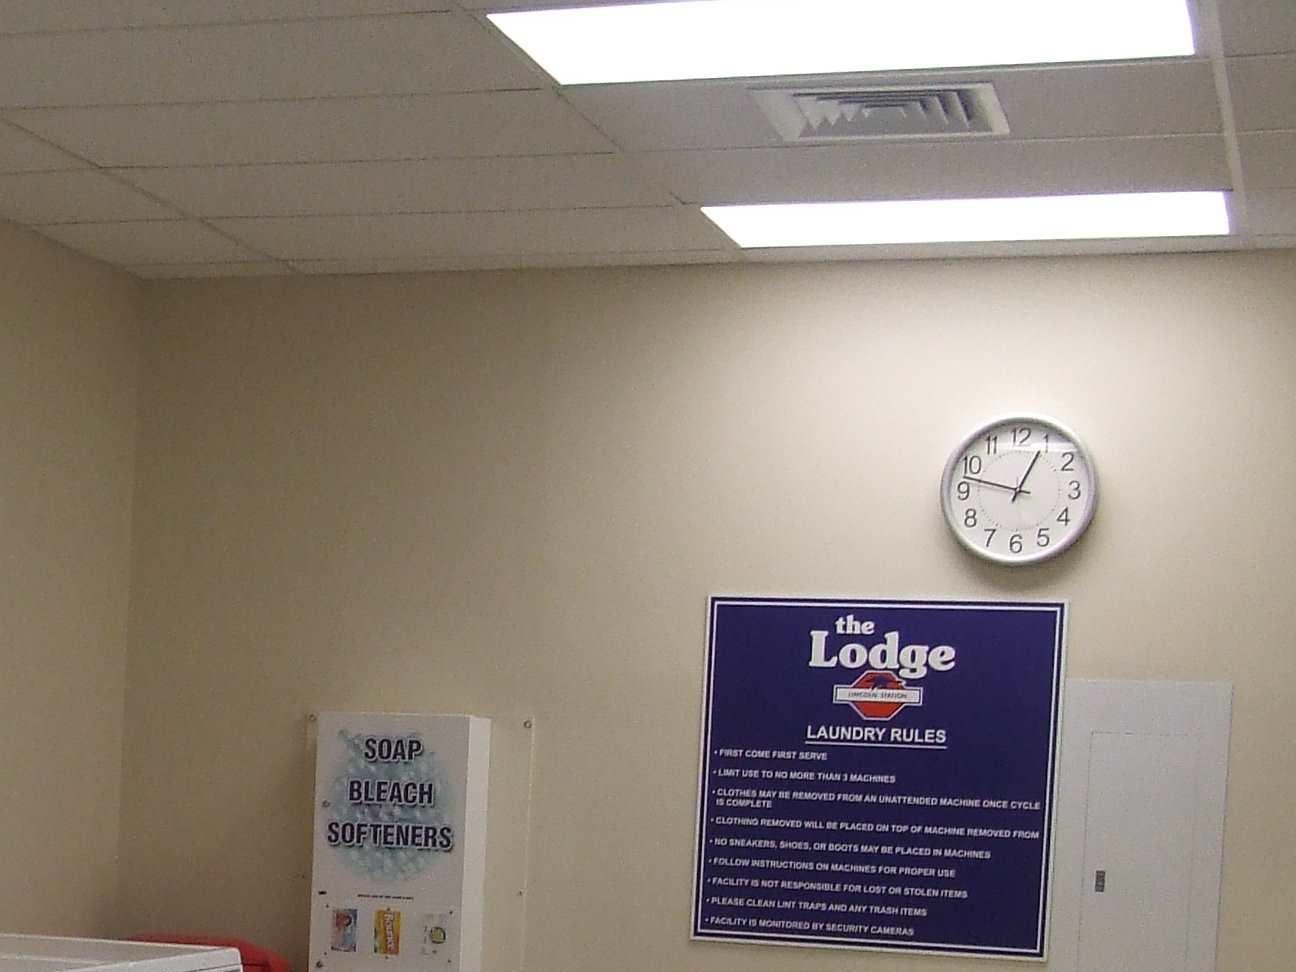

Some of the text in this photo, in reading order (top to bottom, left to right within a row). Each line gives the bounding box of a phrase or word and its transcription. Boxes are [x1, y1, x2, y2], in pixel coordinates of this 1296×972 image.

[986, 435, 997, 455] 11
[1011, 427, 1031, 444] 12
[1043, 434, 1048, 453] 1
[963, 456, 982, 474] 10
[1061, 452, 1074, 471] 2
[957, 481, 970, 501] 9
[1068, 480, 1081, 499] 3
[964, 508, 977, 527] 8
[1056, 508, 1070, 526] 4
[984, 529, 996, 547] 7
[1009, 535, 1022, 553] 6
[1037, 528, 1049, 547] 5
[835, 614, 875, 634] the
[809, 630, 955, 678] Lodge
[807, 726, 946, 743] LAUNDRY RULES
[364, 738, 422, 761] SOAP
[775, 771, 788, 779] NO
[790, 772, 815, 780] MORE
[849, 774, 895, 783] MACHINES
[349, 780, 433, 804] BLEACH
[793, 792, 835, 800] REMOVED
[879, 796, 938, 805] UNATTENDED
[940, 798, 980, 807] MACHINE
[983, 800, 1008, 808] ONCE
[1011, 801, 1040, 809] CYCLE
[726, 799, 772, 808] COMPLETE
[328, 822, 452, 848] SOFTENERS
[716, 817, 758, 825] CLOTHING
[761, 819, 801, 827] REMOVED
[804, 820, 824, 828] WILL
[840, 822, 873, 831] PLACED
[924, 826, 965, 835] MACHINE
[967, 828, 1010, 837] REMOVED
[1013, 831, 1039, 839] FROM
[828, 843, 858, 851] BOOTS
[861, 844, 880, 854] MAY
[895, 847, 931, 855] PLACED
[944, 849, 990, 859] MACHINES
[713, 858, 749, 866] FOLLOW
[751, 859, 814, 870] INSTRUCTIONS
[831, 864, 876, 873] MACHINES
[899, 867, 935, 876] PROPER
[937, 869, 955, 877] USE
[712, 878, 749, 886] FACILITY
[751, 879, 759, 887] IS
[761, 880, 779, 888] NOT
[781, 881, 840, 891] RESPONSIBLE
[843, 884, 861, 892] FOR
[864, 886, 886, 894] LOST
[904, 888, 939, 897] STOLEN
[941, 890, 968, 898] ITEMS
[712, 897, 927, 916] PLEASE CLEAN LINT TRAPS AND ANY TRASH ITEMS
[710, 917, 914, 935] FACILITY IS MONITORED BY SECURITY CAMERAS
